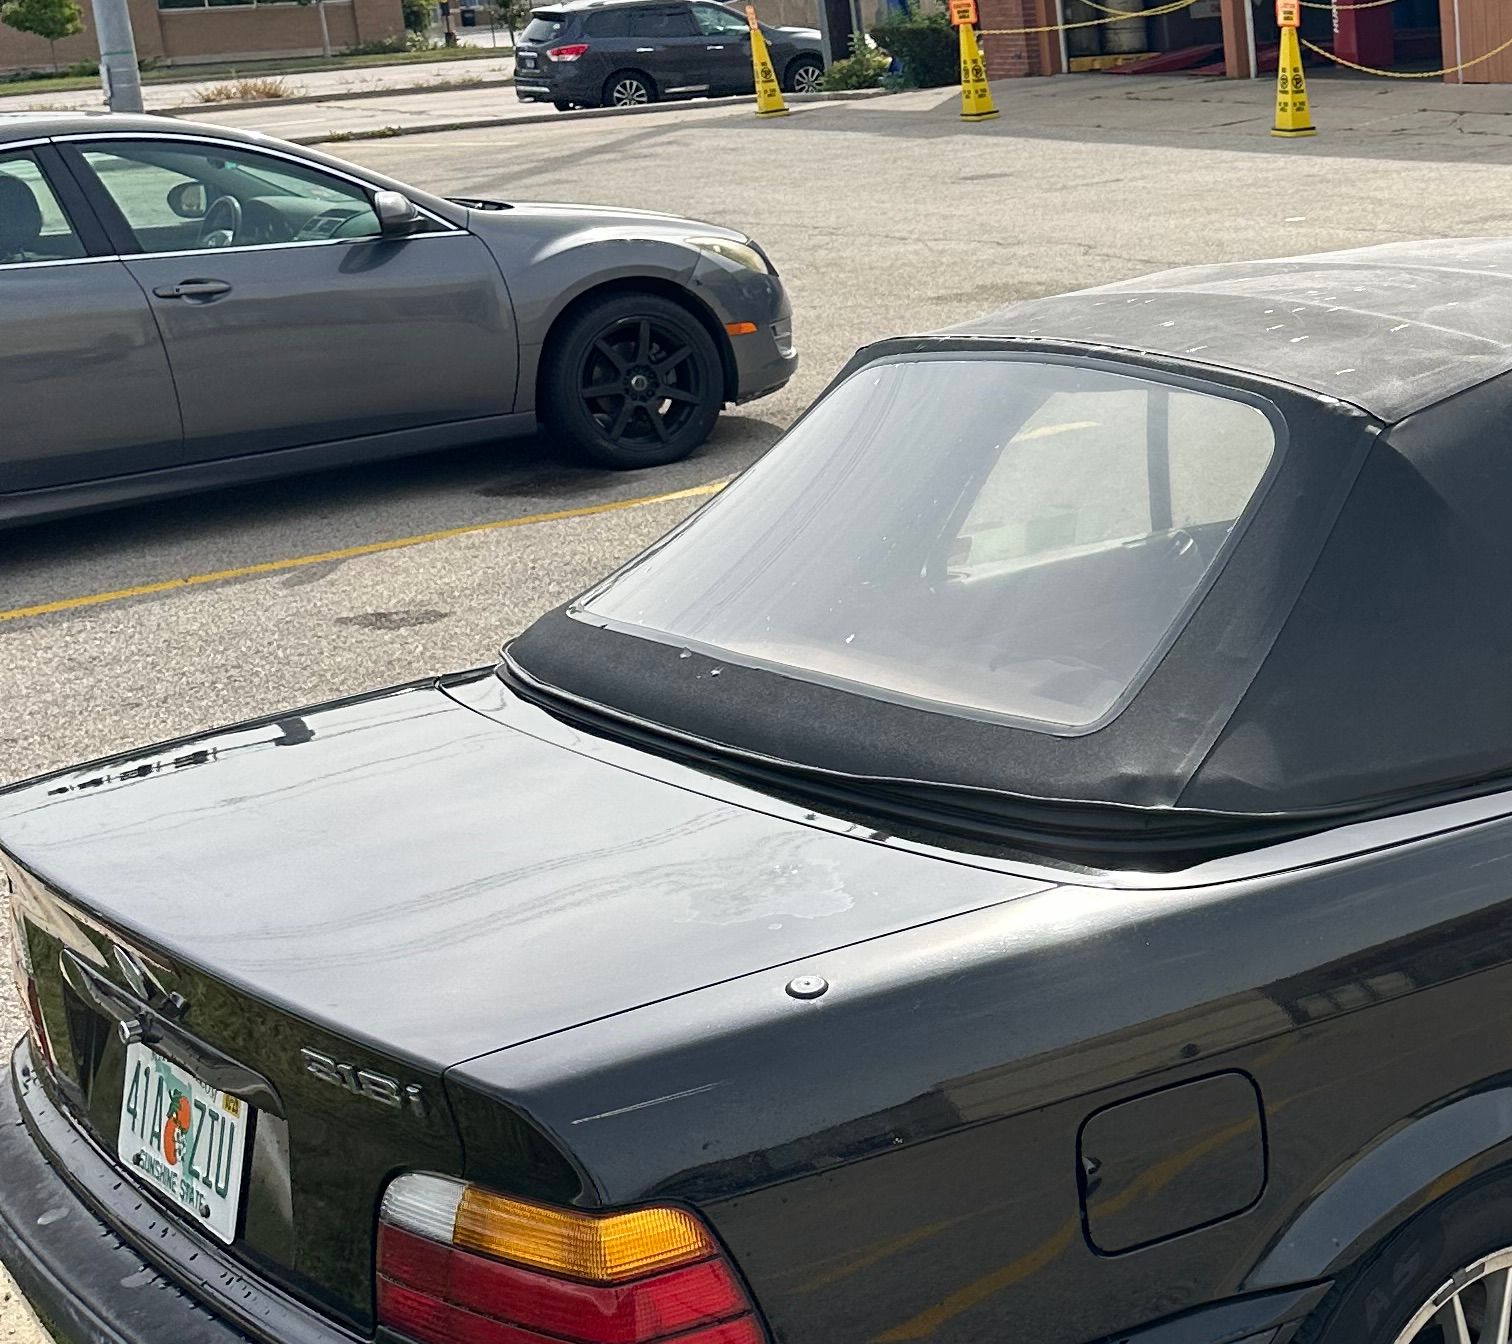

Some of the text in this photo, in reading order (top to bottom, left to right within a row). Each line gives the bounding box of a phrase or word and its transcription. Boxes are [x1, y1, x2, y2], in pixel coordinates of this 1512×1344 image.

[127, 1060, 235, 1199] 41A ZIU
[139, 1149, 178, 1192] SUNSHINE
